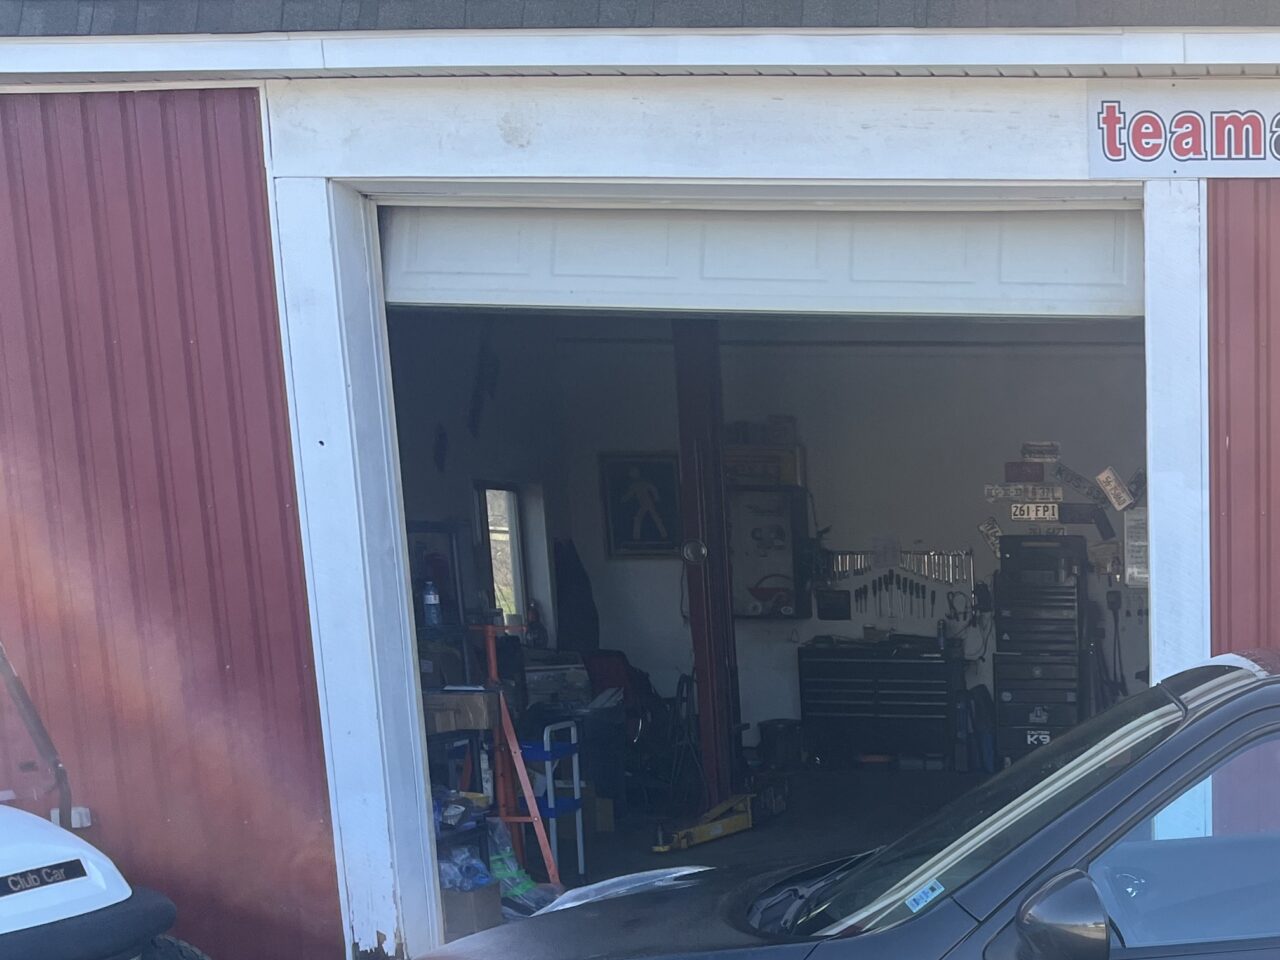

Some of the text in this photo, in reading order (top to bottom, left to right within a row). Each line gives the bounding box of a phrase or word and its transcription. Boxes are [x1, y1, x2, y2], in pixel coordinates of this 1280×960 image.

[1027, 735, 1050, 744] K9
[8, 868, 66, 891] Club Car
